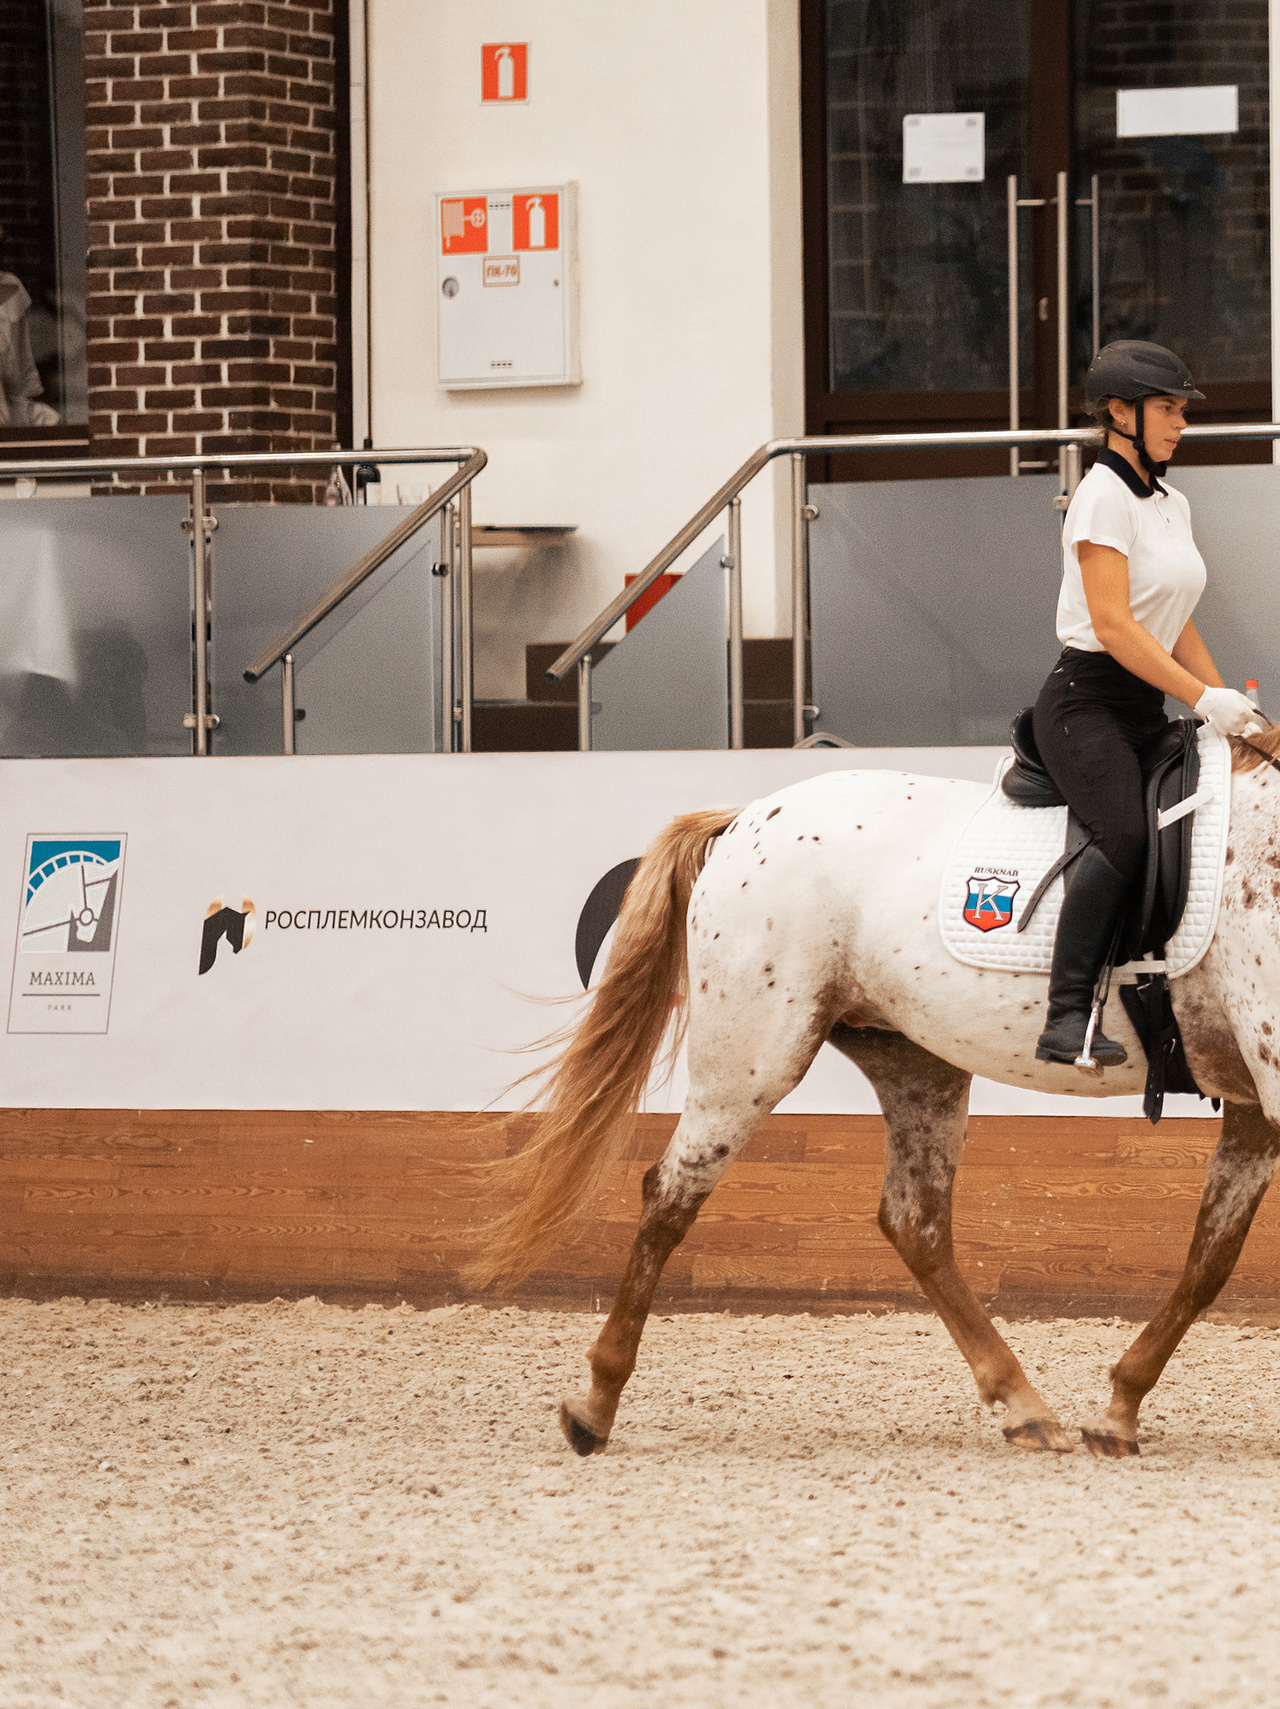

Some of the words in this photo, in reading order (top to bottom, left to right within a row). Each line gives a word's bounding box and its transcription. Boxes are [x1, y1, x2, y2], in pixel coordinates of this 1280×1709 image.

[974, 867, 1019, 877] RUSKNAB
[971, 883, 1009, 922] K
[264, 909, 488, 933] РОСПЛЕМКОНЗАВОД
[28, 971, 96, 986] MAXIMA
